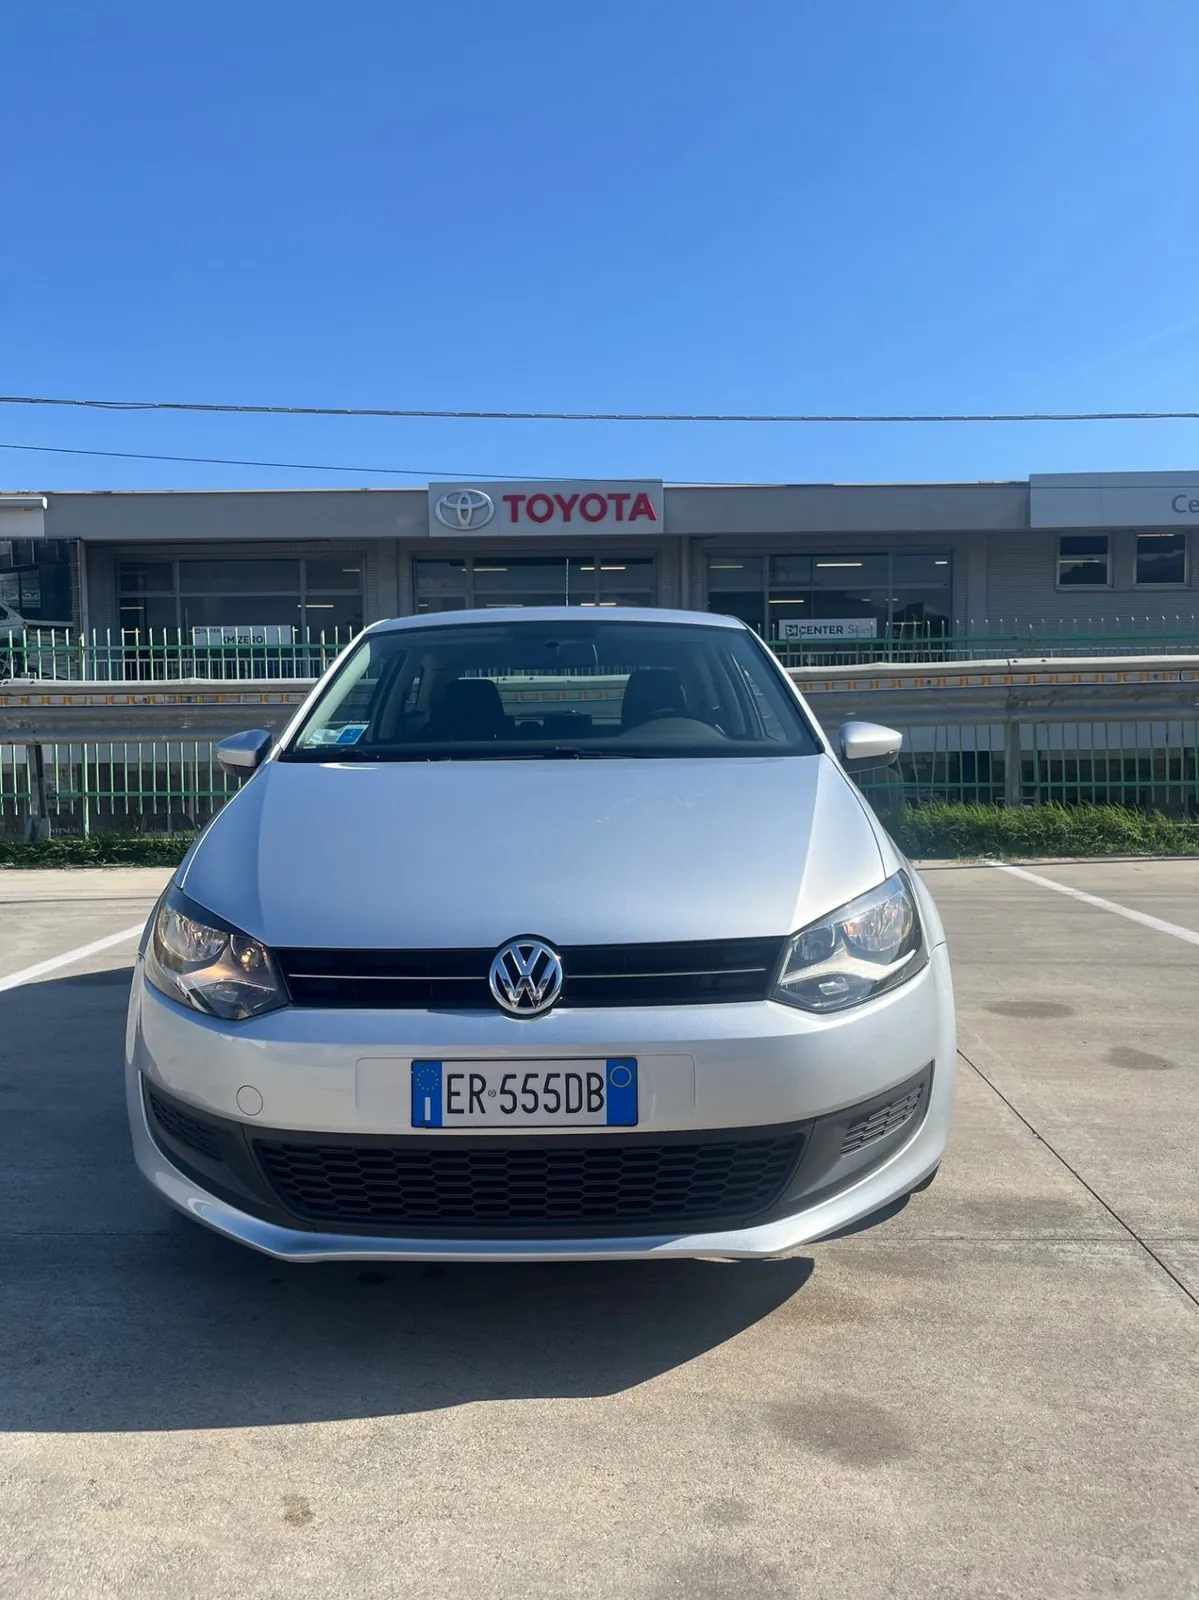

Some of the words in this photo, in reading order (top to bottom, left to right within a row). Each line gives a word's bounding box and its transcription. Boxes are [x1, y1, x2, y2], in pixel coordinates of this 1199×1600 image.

[502, 493, 658, 523] TOYOTA
[799, 625, 844, 635] CENTER
[237, 635, 264, 644] ZERO
